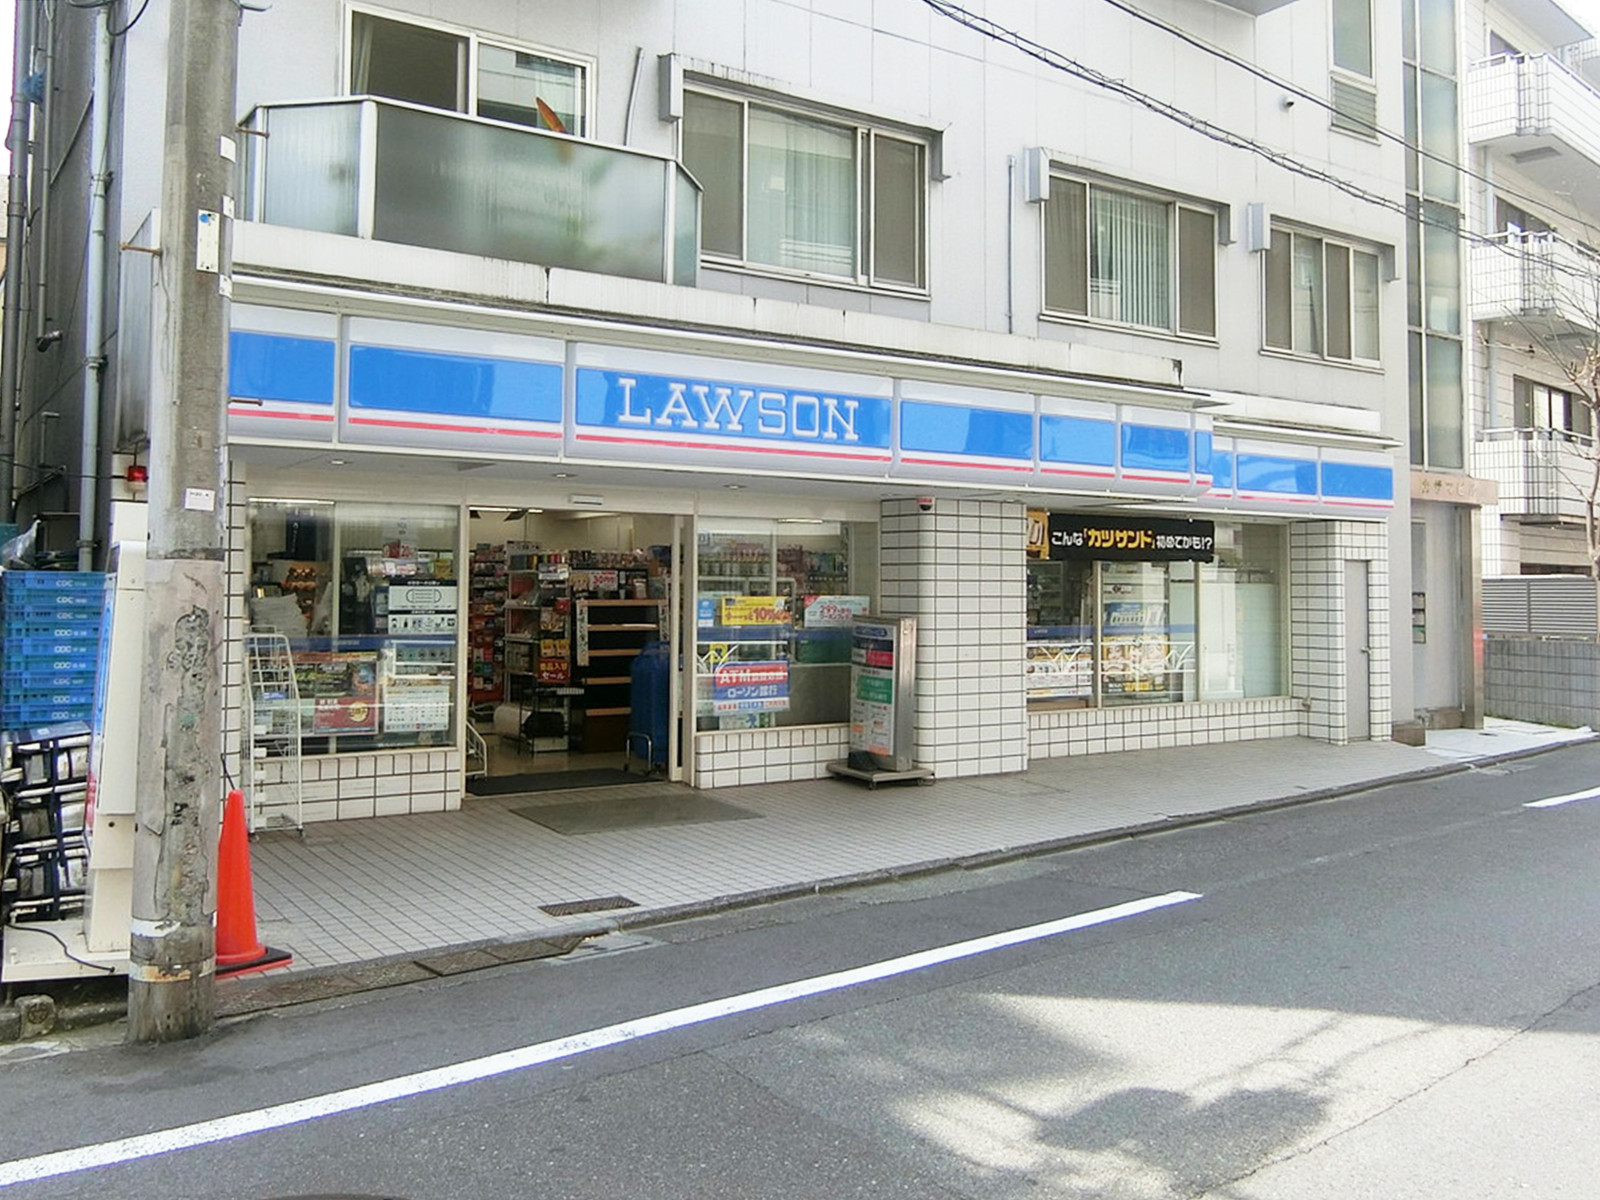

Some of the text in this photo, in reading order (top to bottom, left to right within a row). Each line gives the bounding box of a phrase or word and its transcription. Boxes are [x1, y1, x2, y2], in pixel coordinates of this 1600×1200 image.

[618, 377, 860, 441] LAWSON
[541, 671, 566, 680] セール
[727, 685, 778, 698] ローソン銀行
